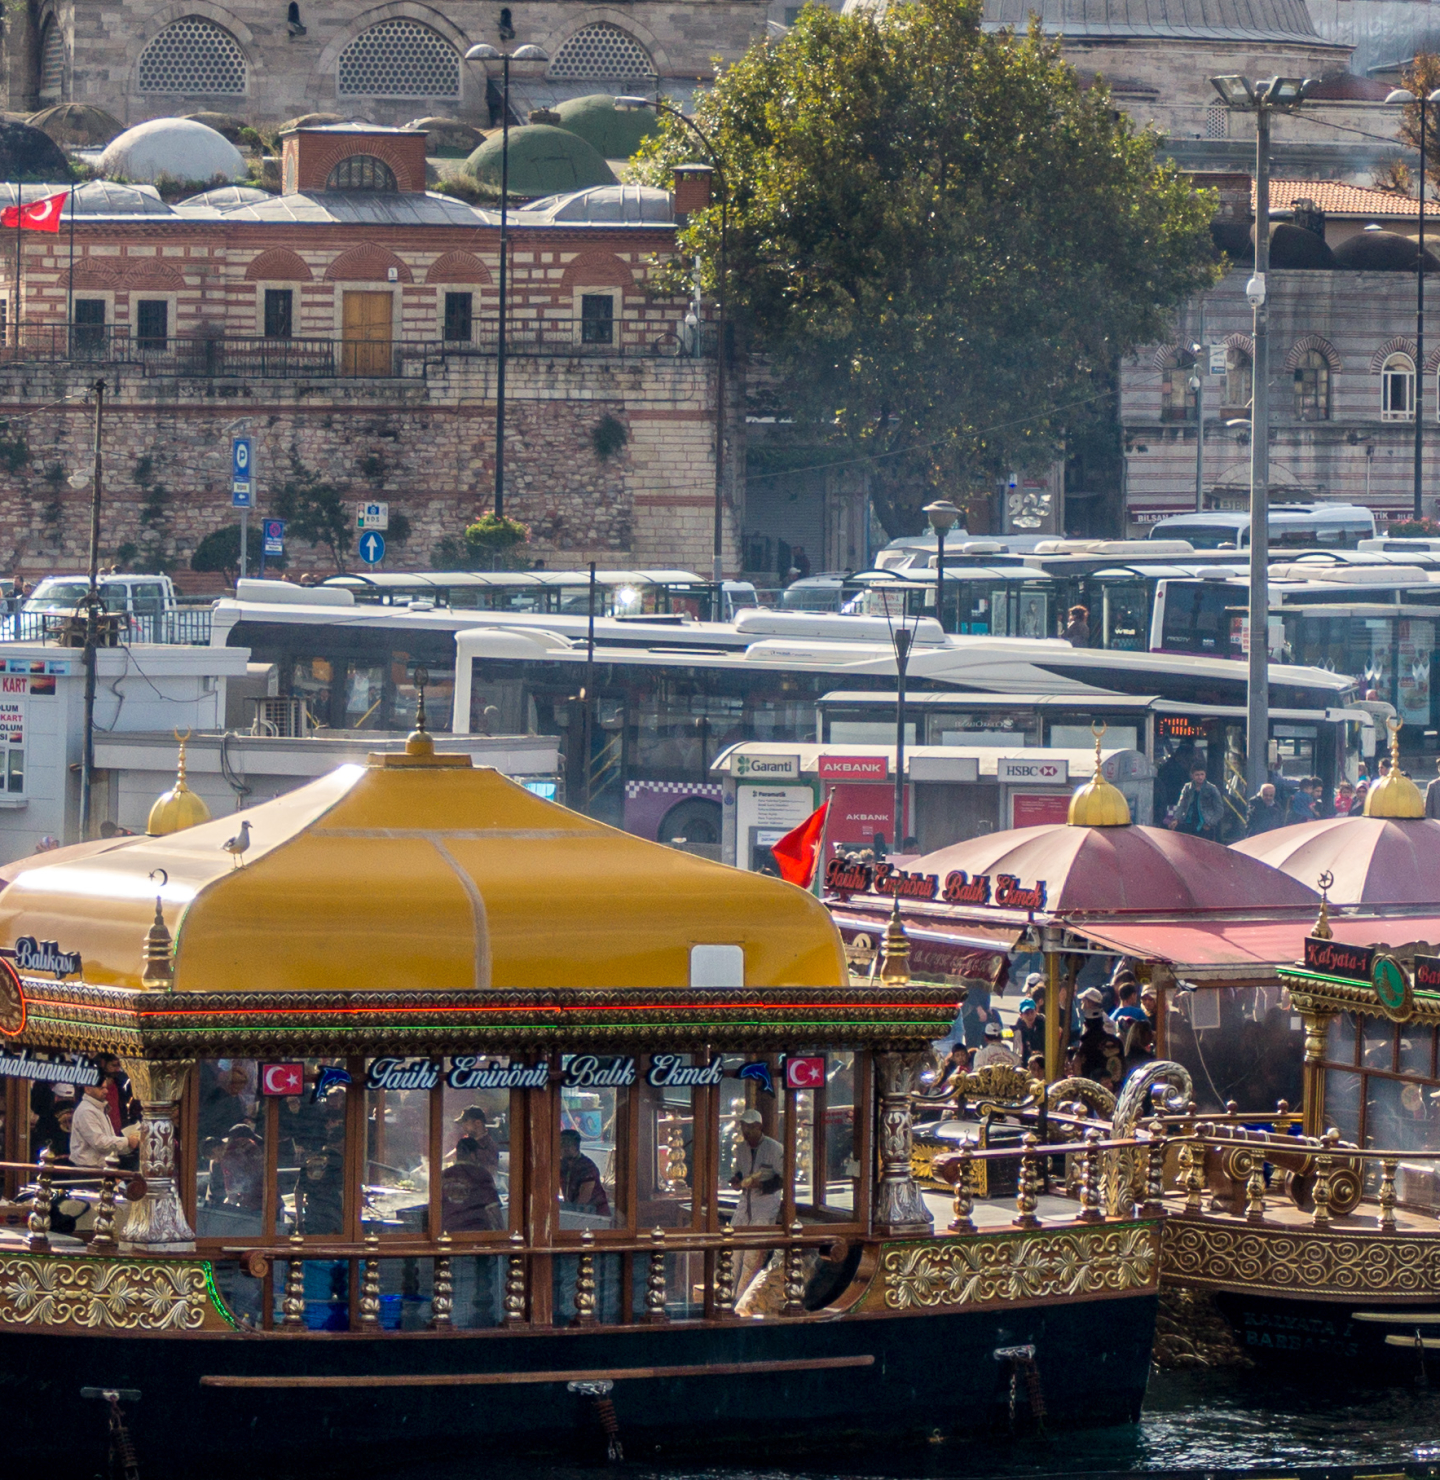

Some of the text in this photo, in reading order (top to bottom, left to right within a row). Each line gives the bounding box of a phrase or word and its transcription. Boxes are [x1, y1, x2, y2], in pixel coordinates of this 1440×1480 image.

[1008, 493, 1052, 516] 925
[2, 677, 27, 693] KART
[0, 714, 23, 722] KART
[751, 759, 792, 772] Garanti
[823, 763, 881, 772] AKBANK
[1006, 765, 1039, 777] HSBC
[825, 860, 1043, 908] Tarihi Emnönü Balık Ekmek
[367, 1054, 723, 1089] Tarihi Eminönü Balık Ekmek
